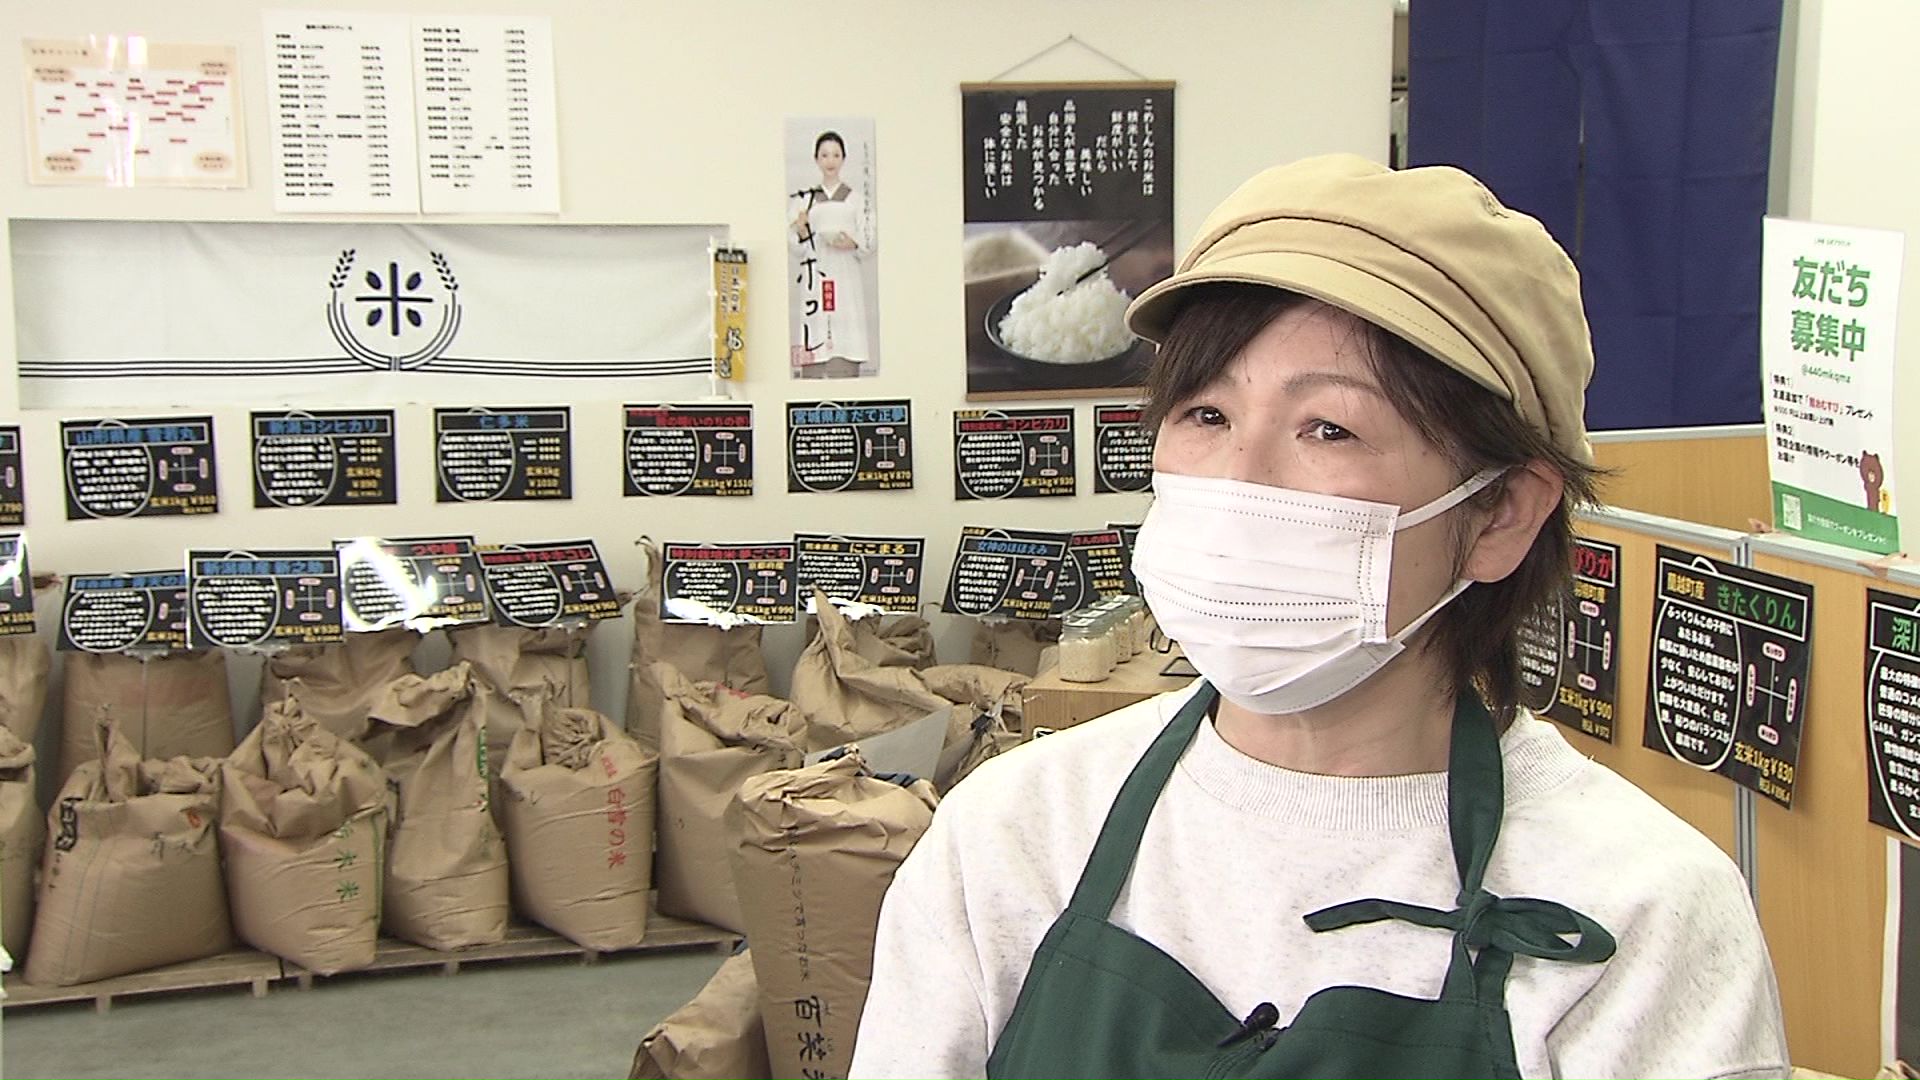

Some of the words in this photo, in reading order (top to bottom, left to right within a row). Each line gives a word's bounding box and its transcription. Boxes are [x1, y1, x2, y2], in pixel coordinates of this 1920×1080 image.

[1047, 111, 1060, 186] 自分に合った
[1080, 147, 1092, 197] 美味しい
[1096, 135, 1107, 173] だから
[1792, 256, 1870, 307] 友だち
[1791, 309, 1867, 362] 募集中
[1006, 416, 1067, 432] コシヒカリ
[848, 543, 906, 556] にこまる
[977, 540, 1048, 556] 女神のほほえみ
[1716, 584, 1797, 631] きたくりん
